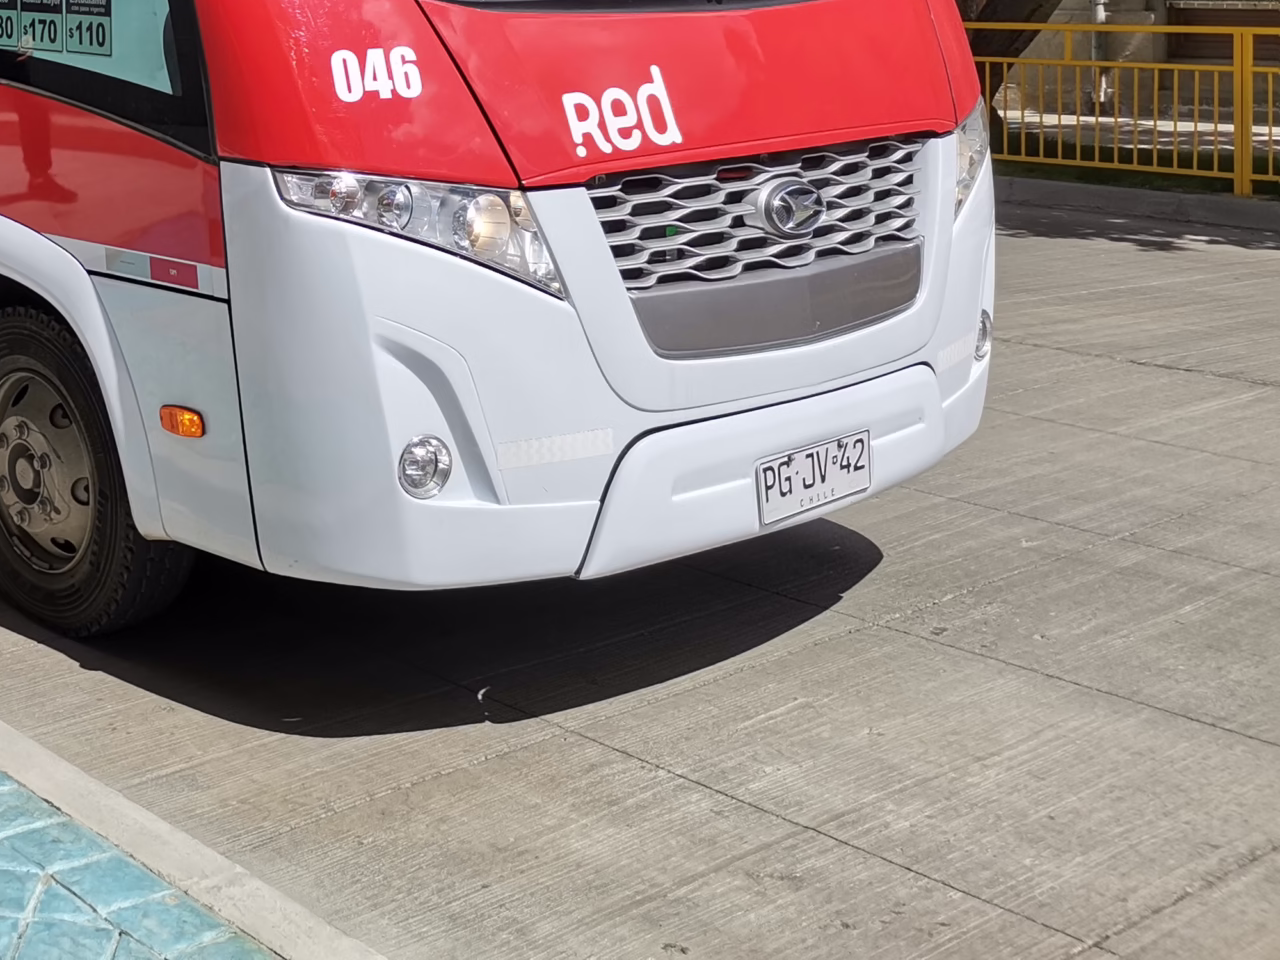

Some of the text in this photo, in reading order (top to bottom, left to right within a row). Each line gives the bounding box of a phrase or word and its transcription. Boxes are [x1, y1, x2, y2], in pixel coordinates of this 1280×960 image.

[23, 17, 58, 44] $170
[68, 20, 106, 48] $110
[330, 45, 423, 103] 046
[561, 64, 683, 158] Red
[800, 487, 836, 508] CHILE
